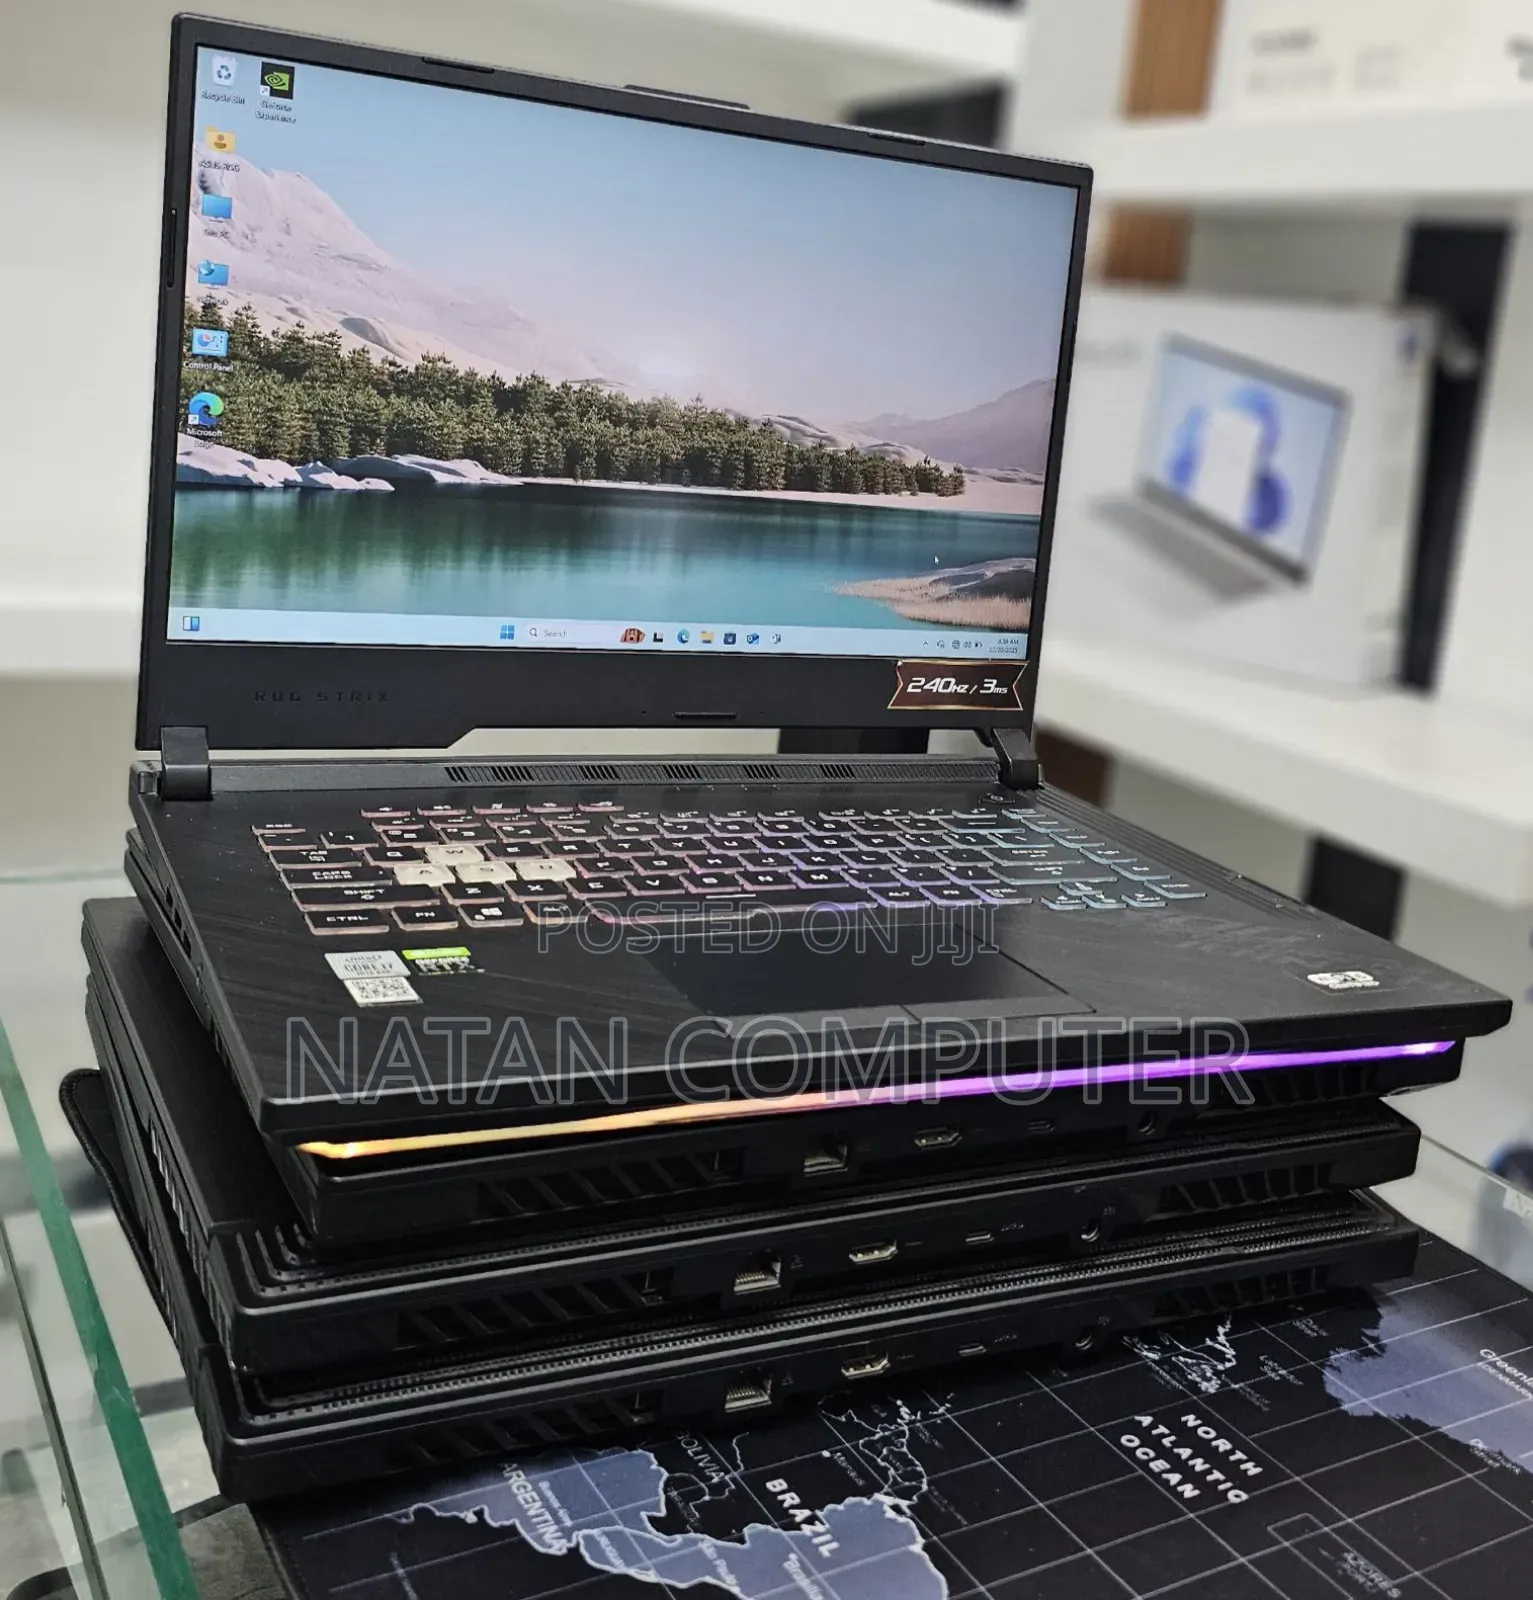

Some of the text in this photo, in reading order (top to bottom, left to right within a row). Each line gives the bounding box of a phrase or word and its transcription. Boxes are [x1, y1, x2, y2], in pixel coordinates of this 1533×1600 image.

[183, 361, 234, 373] Control Panel
[187, 427, 223, 437] Microsoft
[194, 440, 214, 450] Edge
[543, 628, 567, 639] Search
[255, 691, 388, 702] ROG STRIX
[980, 678, 1008, 694] 3ms
[676, 1429, 725, 1484] BOLIVIA
[1133, 1415, 1250, 1504] ATLANTIC
[1180, 1413, 1264, 1477] NORTH
[1119, 1433, 1202, 1499] OCEAN
[501, 1462, 568, 1552] ARGENTINA
[765, 1478, 841, 1558] BRAZIL
